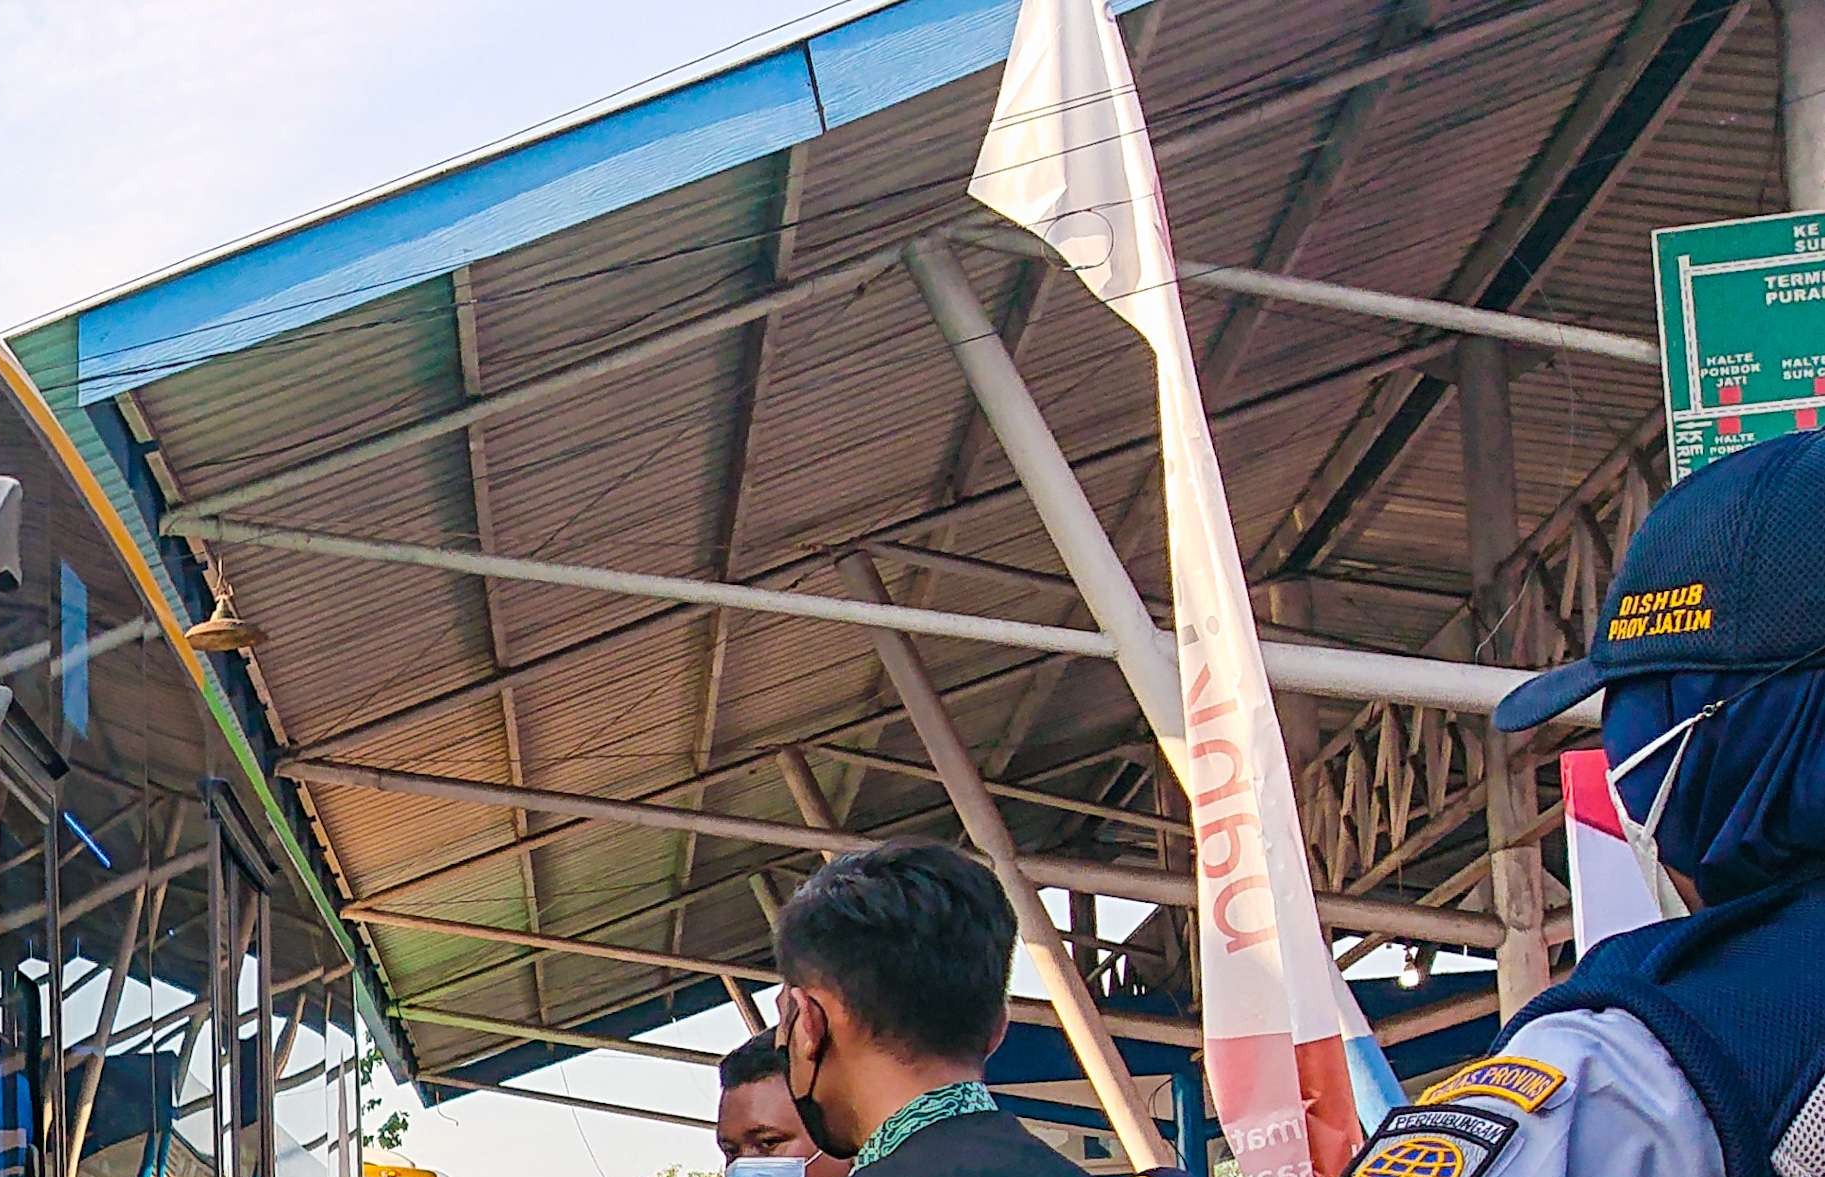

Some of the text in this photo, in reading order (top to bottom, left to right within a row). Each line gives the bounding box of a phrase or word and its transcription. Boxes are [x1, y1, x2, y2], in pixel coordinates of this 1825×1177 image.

[1792, 223, 1821, 239] KE
[1706, 352, 1754, 367] HALTE
[1701, 362, 1761, 378] PONDOK
[1783, 370, 1814, 380] SUN
[1715, 376, 1747, 388] JATI
[1714, 433, 1755, 444] HALTE
[1619, 583, 1705, 617] DISHUB
